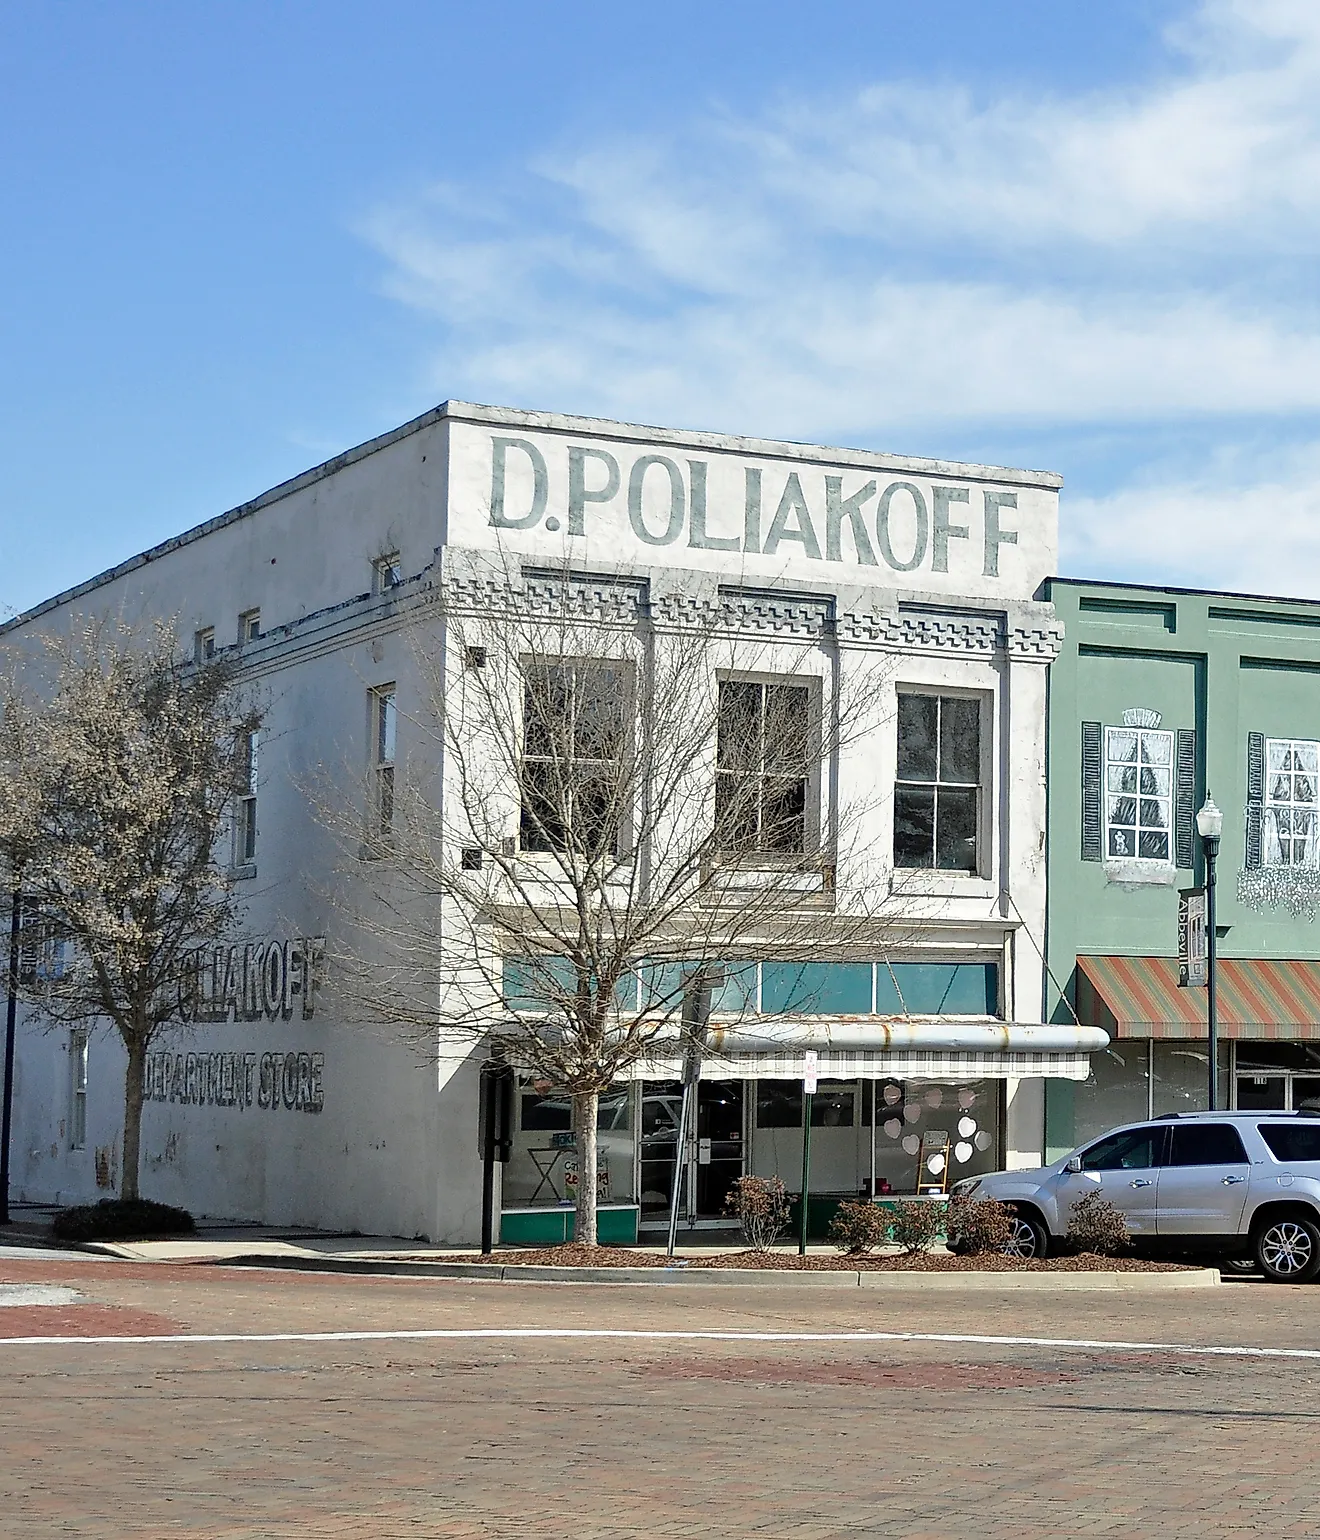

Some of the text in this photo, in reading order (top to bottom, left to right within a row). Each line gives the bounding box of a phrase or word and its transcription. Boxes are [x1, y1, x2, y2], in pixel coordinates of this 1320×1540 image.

[1178, 899, 1189, 976] Abbeville
[144, 1052, 325, 1114] DEPARTMENT STORE
